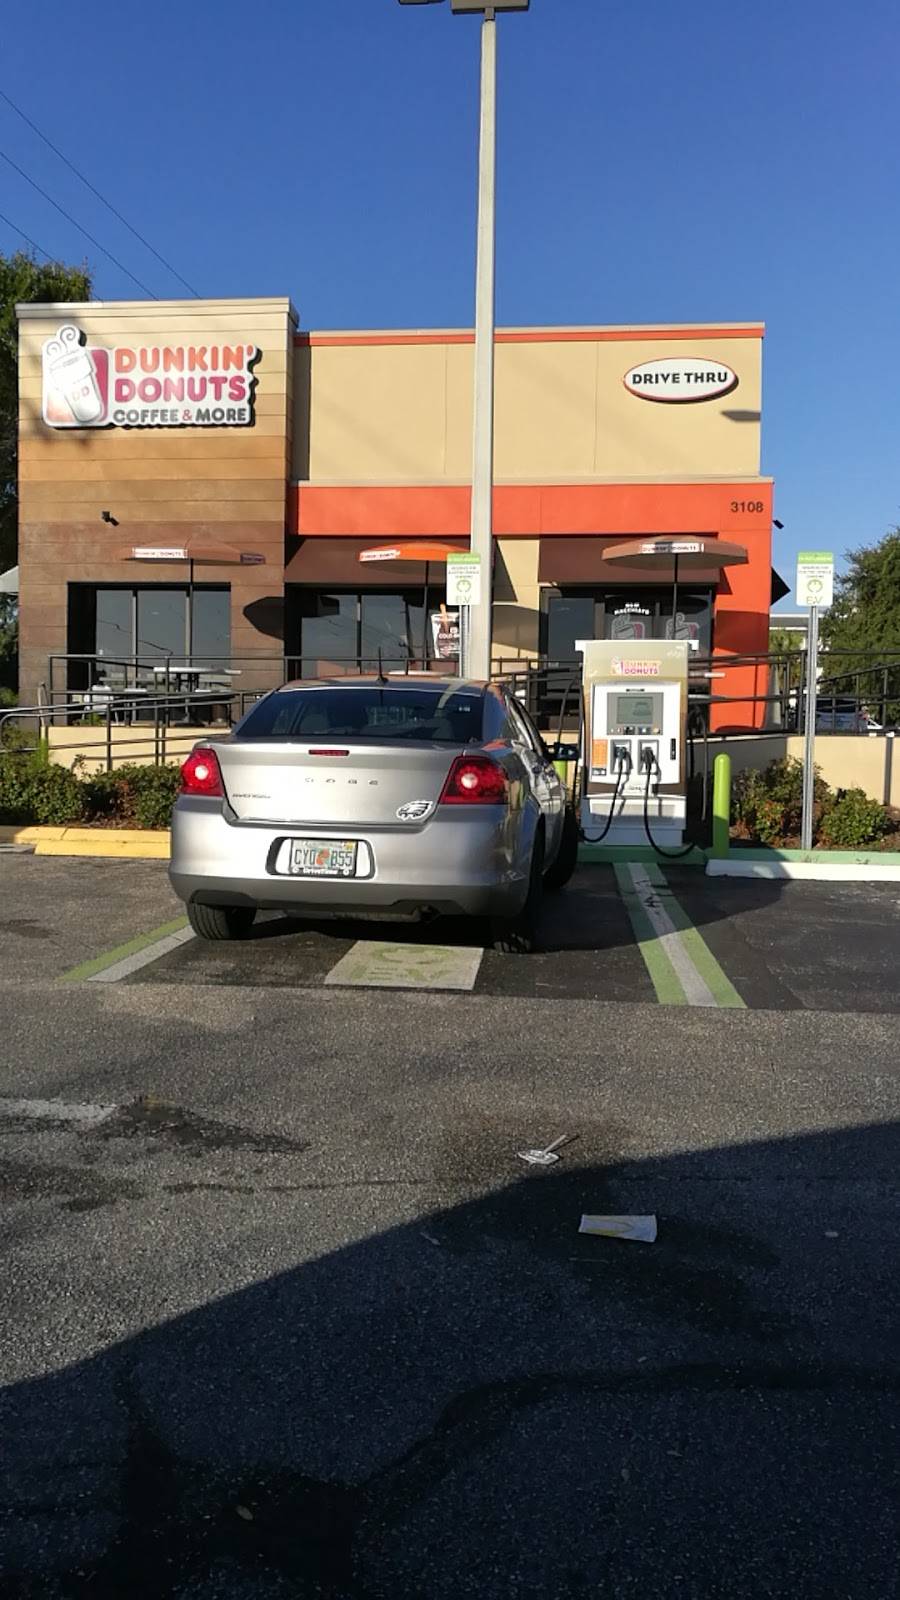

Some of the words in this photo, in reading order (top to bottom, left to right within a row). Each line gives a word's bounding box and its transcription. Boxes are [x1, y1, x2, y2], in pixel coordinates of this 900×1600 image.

[115, 345, 254, 373] DUNKIN'
[632, 373, 681, 384] DRIVE
[684, 372, 728, 383] THRU
[114, 376, 247, 403] DONUTS
[113, 408, 178, 423] COFFEE
[182, 409, 192, 421] &
[195, 408, 247, 422] MORE
[730, 501, 764, 513] 3108
[624, 667, 658, 675] DONUTS
